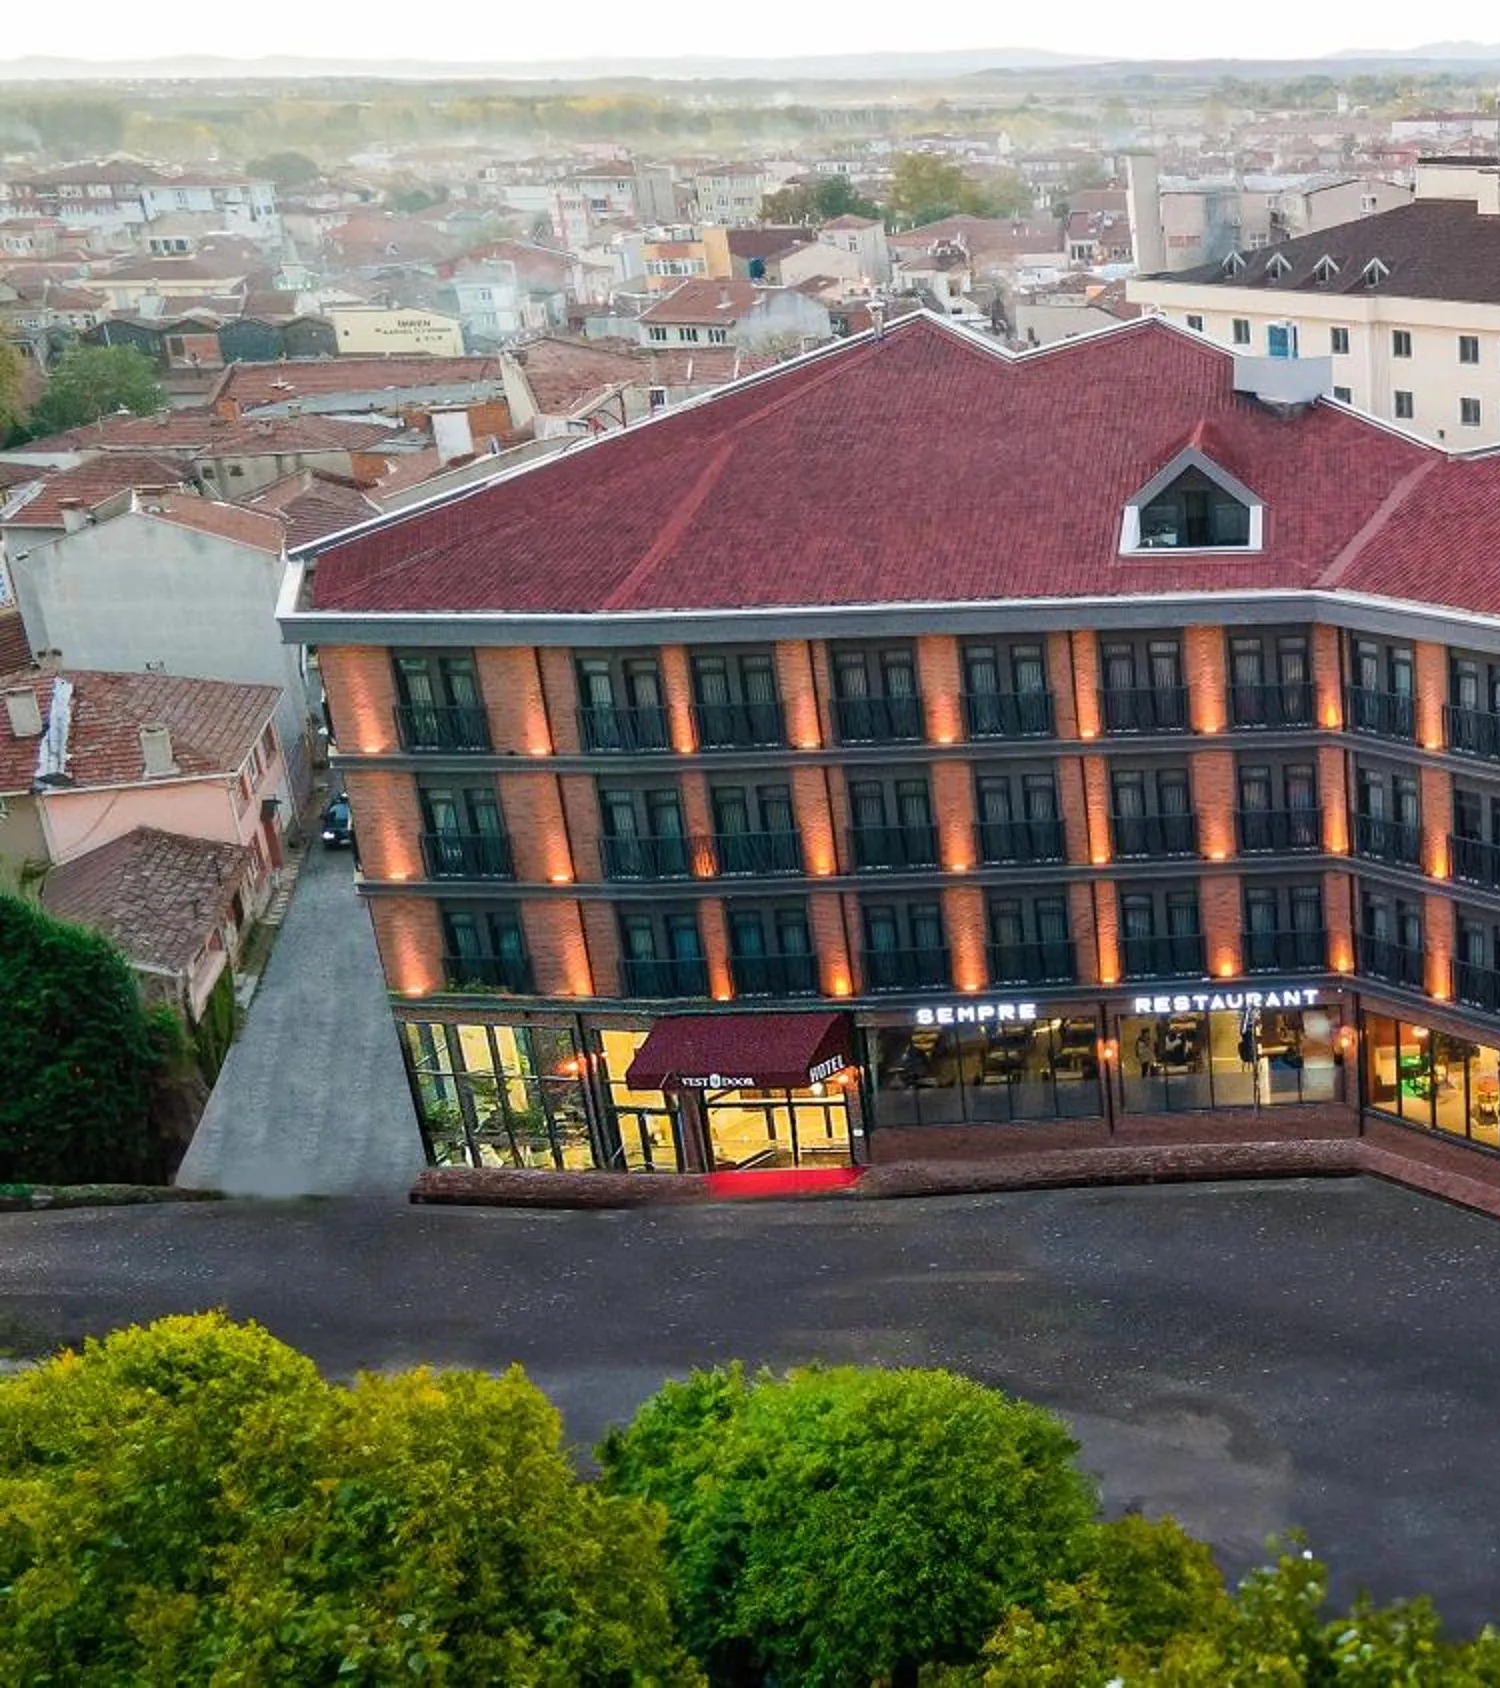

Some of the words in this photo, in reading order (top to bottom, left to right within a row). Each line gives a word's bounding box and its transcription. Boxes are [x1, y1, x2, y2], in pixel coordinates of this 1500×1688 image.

[916, 1003, 1038, 1025] SEMPRE
[1135, 989, 1319, 1014] RESTAURANT
[809, 1054, 846, 1083] HOTEL
